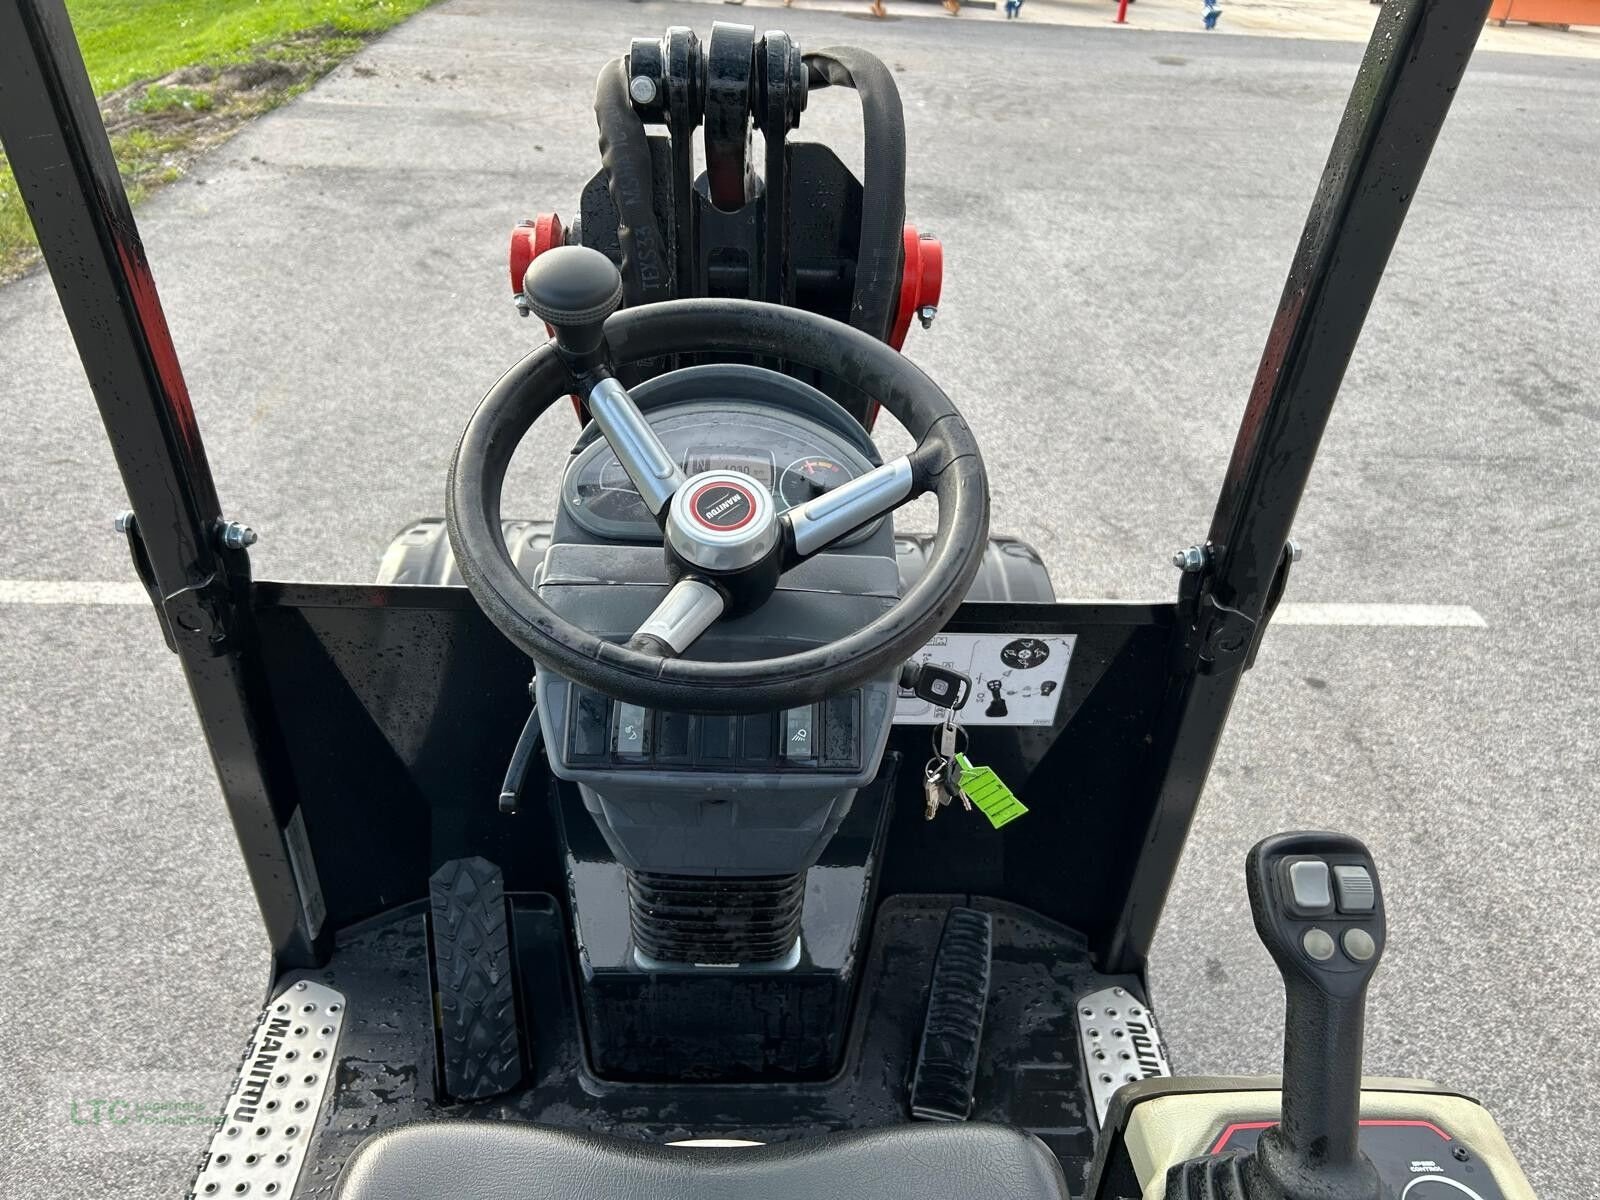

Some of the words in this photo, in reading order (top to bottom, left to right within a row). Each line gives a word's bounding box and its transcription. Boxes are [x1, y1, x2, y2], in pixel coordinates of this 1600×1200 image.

[705, 493, 741, 520] MANITOU
[233, 1018, 292, 1123] MANITOU
[1125, 1021, 1162, 1079] NITOU
